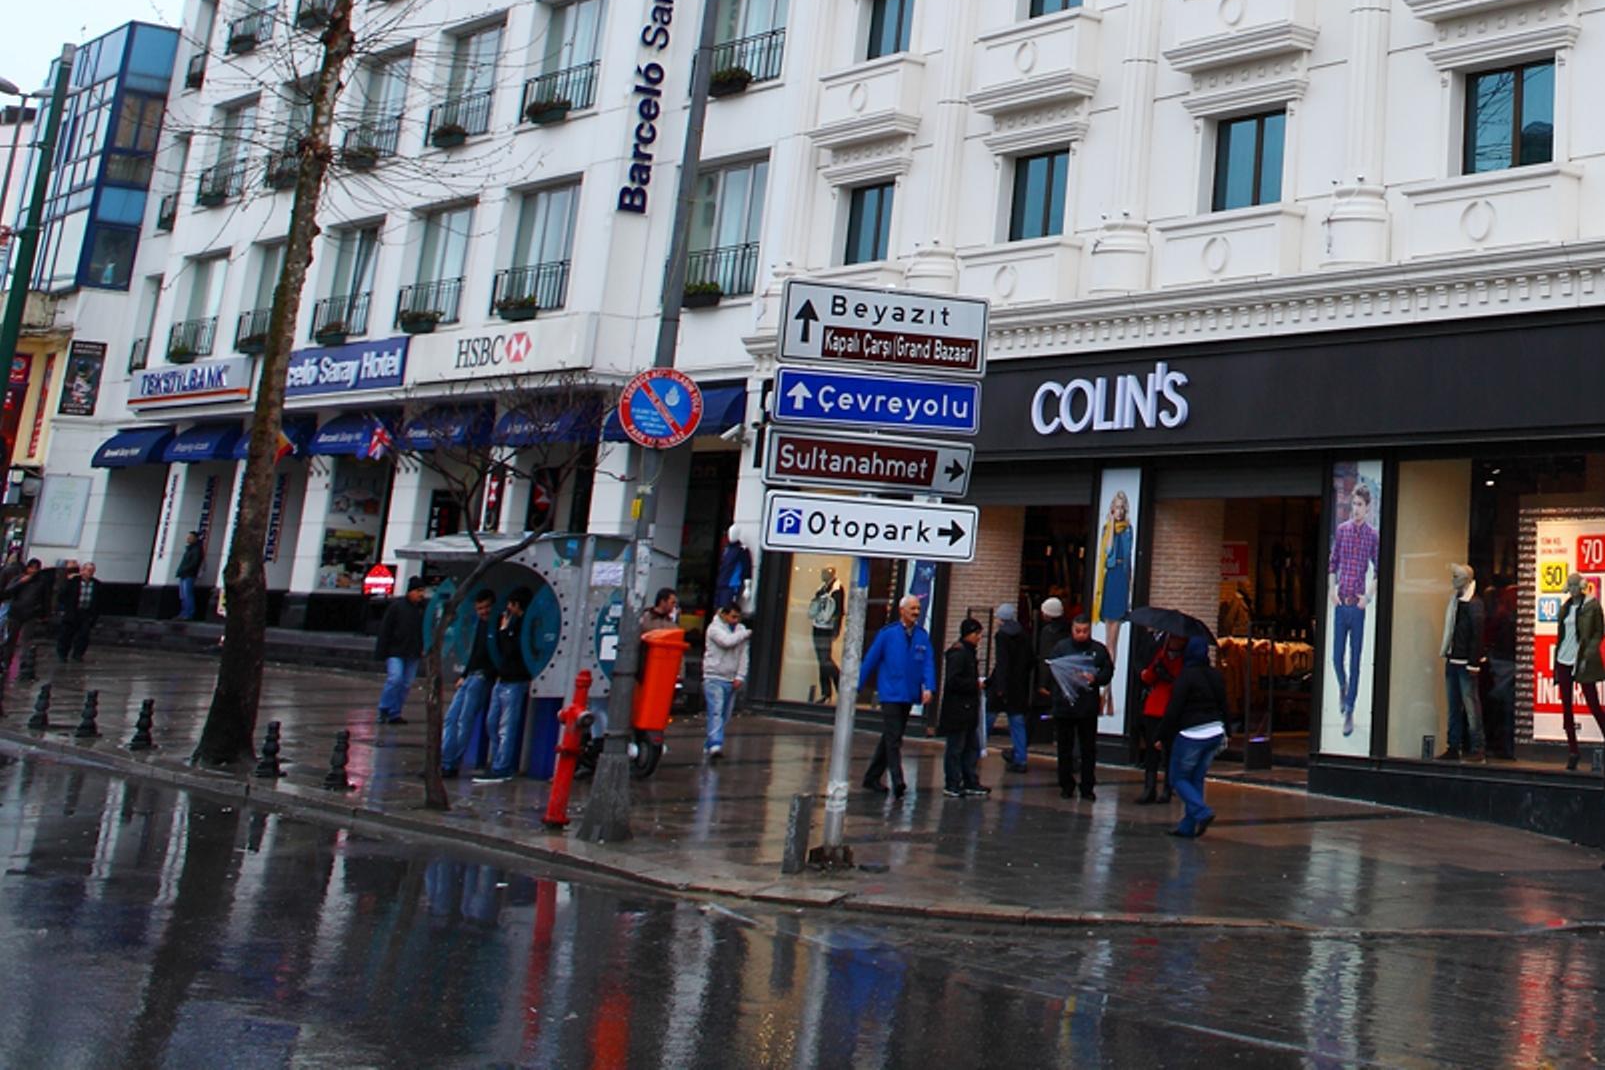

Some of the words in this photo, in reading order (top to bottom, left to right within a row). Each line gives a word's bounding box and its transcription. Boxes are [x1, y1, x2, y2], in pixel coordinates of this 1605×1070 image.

[616, 61, 666, 216] Barceló
[830, 295, 951, 327] Beyazıt
[455, 335, 505, 368] HSBC
[824, 329, 861, 354] Kapalı
[863, 333, 892, 358] Çarşı
[893, 335, 931, 359] (Grand
[934, 340, 977, 364] Bazaar)
[285, 356, 319, 388] celó
[319, 356, 360, 389] Saray
[360, 347, 402, 380] Hotel
[817, 385, 970, 421] Çevreyolu
[1031, 362, 1189, 435] COLIN'S
[780, 444, 929, 480] Sultanahmet
[807, 511, 931, 545] Otopark
